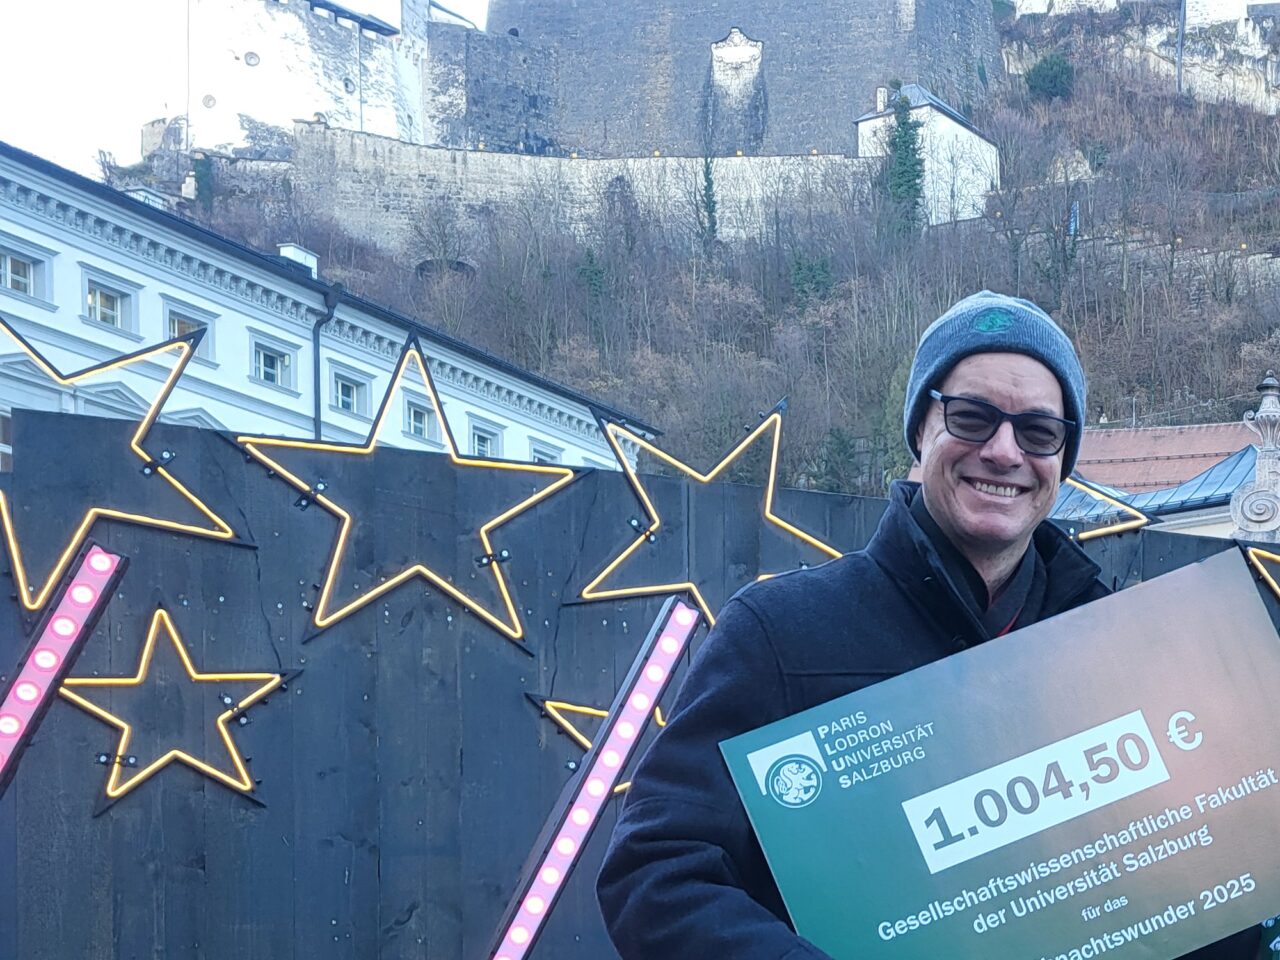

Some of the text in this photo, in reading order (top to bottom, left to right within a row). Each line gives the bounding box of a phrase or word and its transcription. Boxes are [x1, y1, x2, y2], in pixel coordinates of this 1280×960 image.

[817, 711, 867, 740] PARIS
[824, 720, 894, 756] LODRON
[831, 722, 935, 772] UNIVERSITÄT
[838, 746, 926, 789] SALZBURG
[924, 732, 1151, 851] 1.004,50
[877, 767, 1280, 942] Gesellschaftswissenschaftliche Fakultät
[973, 824, 1214, 935] der Universität Salzburg
[1199, 872, 1256, 913] 2025
[1081, 894, 1129, 922] für das
